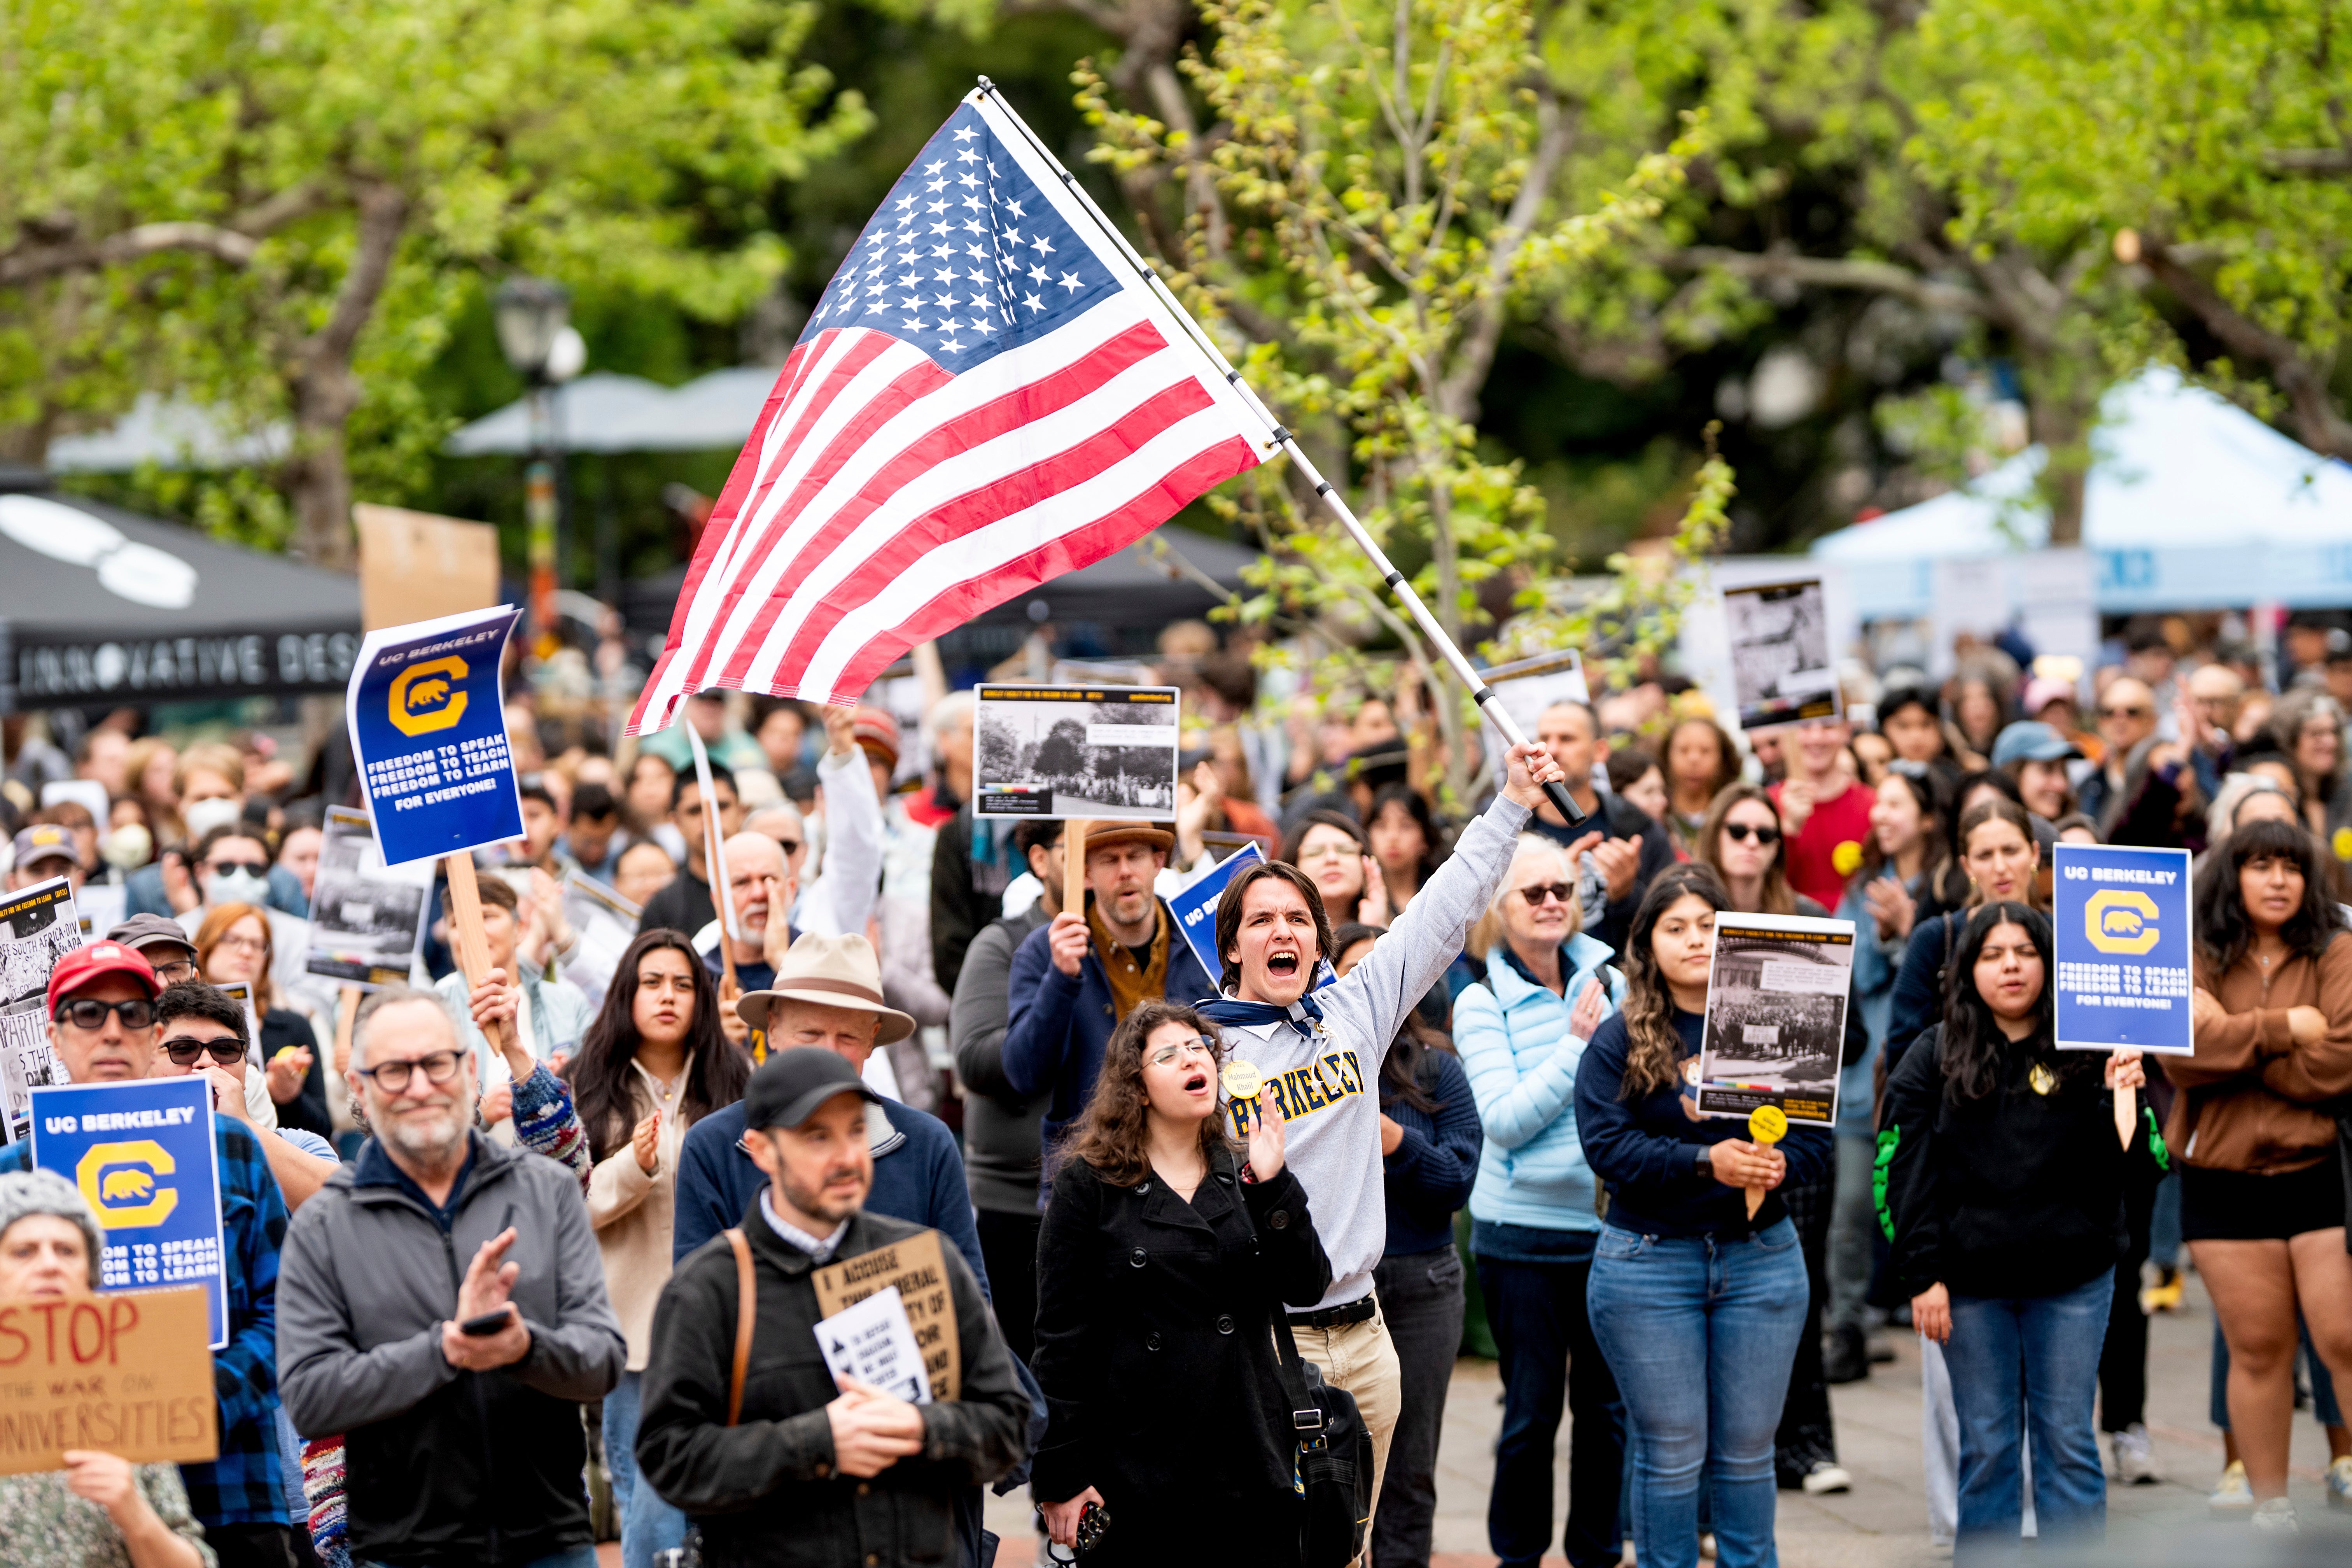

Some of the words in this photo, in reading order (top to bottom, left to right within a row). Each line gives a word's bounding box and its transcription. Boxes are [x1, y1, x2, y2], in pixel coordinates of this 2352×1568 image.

[379, 652, 404, 666] UC
[407, 628, 500, 659] BERKELEY
[19, 635, 268, 695] INNOVATIVE
[277, 632, 359, 683] DES
[367, 749, 436, 775] FREEDOM
[438, 745, 458, 758] TO
[460, 733, 506, 753] SPEAK
[369, 761, 438, 787] FREEDOM
[440, 757, 460, 770] TO
[462, 746, 508, 765] TEACH
[372, 774, 441, 800] FREEDOM
[443, 769, 463, 782] TO
[466, 758, 510, 778] LEARN
[394, 795, 424, 812] FOR
[424, 778, 497, 805] EVERYONE!
[2064, 866, 2088, 880] UC
[2092, 867, 2177, 885] BERKELEY
[22, 899, 37, 909] FREEDOM
[41, 894, 52, 903] LEARN
[1185, 907, 1204, 927] UC
[12, 940, 37, 956] SOUTH
[2059, 962, 2120, 974] FREEDOM
[2123, 965, 2141, 975] TO
[2144, 966, 2187, 977] SPEAK
[2059, 971, 2120, 984] FREEDOM
[2123, 975, 2141, 985] TO
[2144, 975, 2188, 987] TEACH
[2059, 980, 2120, 994] FREEDOM
[2123, 984, 2142, 995] TO
[2145, 985, 2188, 997] LEARN
[2076, 994, 2101, 1006] FOR
[2103, 996, 2172, 1010] EVERYONE!
[1228, 1071, 1256, 1081] Mahmoud
[1237, 1082, 1254, 1091] Khalil
[46, 1116, 77, 1134] UC
[82, 1106, 196, 1132] BERKELEY
[132, 1243, 157, 1257] TO
[161, 1236, 218, 1255] SPEAK
[132, 1256, 158, 1270] TO
[161, 1250, 218, 1268] TEACH
[134, 1269, 159, 1283] TO
[163, 1262, 219, 1281] LEARN
[0, 1297, 140, 1366] STOP
[2, 1379, 35, 1399] THE
[46, 1374, 108, 1398] WAR
[121, 1371, 158, 1394] ON
[2, 1395, 208, 1456] NIVERSITIES
